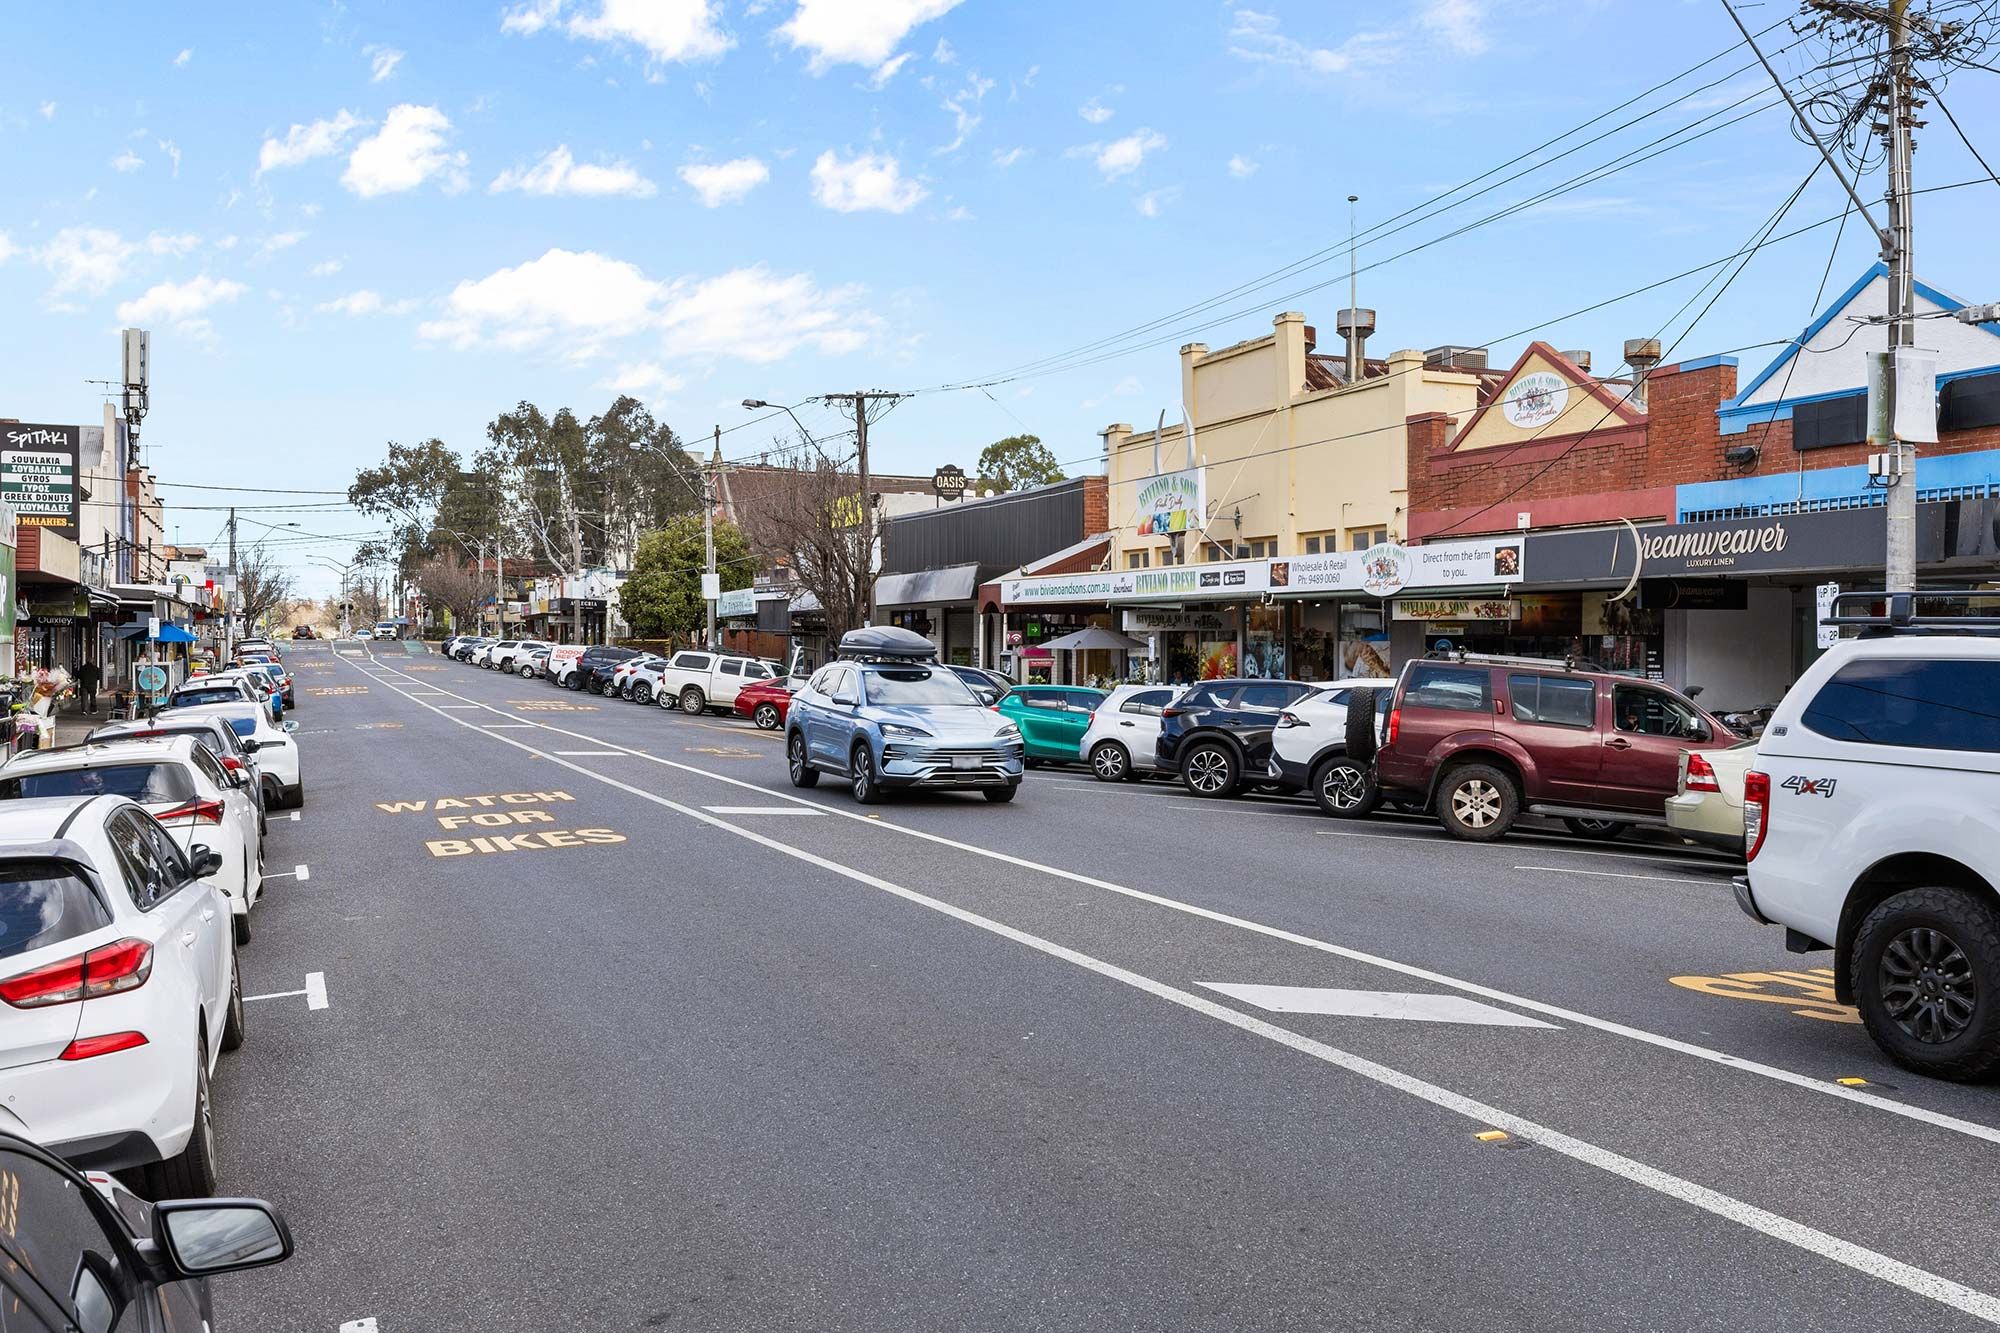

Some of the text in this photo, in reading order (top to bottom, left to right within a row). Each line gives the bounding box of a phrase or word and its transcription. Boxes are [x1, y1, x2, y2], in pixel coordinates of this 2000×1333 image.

[12, 455, 60, 464] SOUVLAKIA
[12, 465, 61, 474] ΣΟΥΒΛΑΚΙΑ
[21, 475, 50, 483] GYROS
[936, 475, 965, 489] OASIS
[22, 484, 50, 493] ΓΥΡΟΣ
[1138, 476, 1199, 508] BIVIANO & SONS
[4, 492, 69, 502] GREEK DONUTS
[22, 517, 67, 526] MALAKIES
[1422, 549, 1491, 564] Direct from the farm
[1605, 516, 1788, 602] Dreamweaver
[1686, 557, 1735, 567] LUXURY LINEN
[1292, 560, 1347, 573] Wholesale & Retail
[1297, 573, 1341, 585] Ph: 9489 0060
[1442, 569, 1450, 578] to
[1024, 582, 1110, 597] www.bivianoandsons.com.au
[1136, 573, 1168, 593] BIVIANO
[1170, 570, 1196, 592] FRESH
[1830, 586, 1837, 597] 1P
[1401, 601, 1470, 614] BIVIANO & SONS
[1829, 630, 1838, 640] 2P
[376, 791, 576, 814] WATCH
[437, 810, 555, 830] FOR
[425, 828, 628, 857] BIKES
